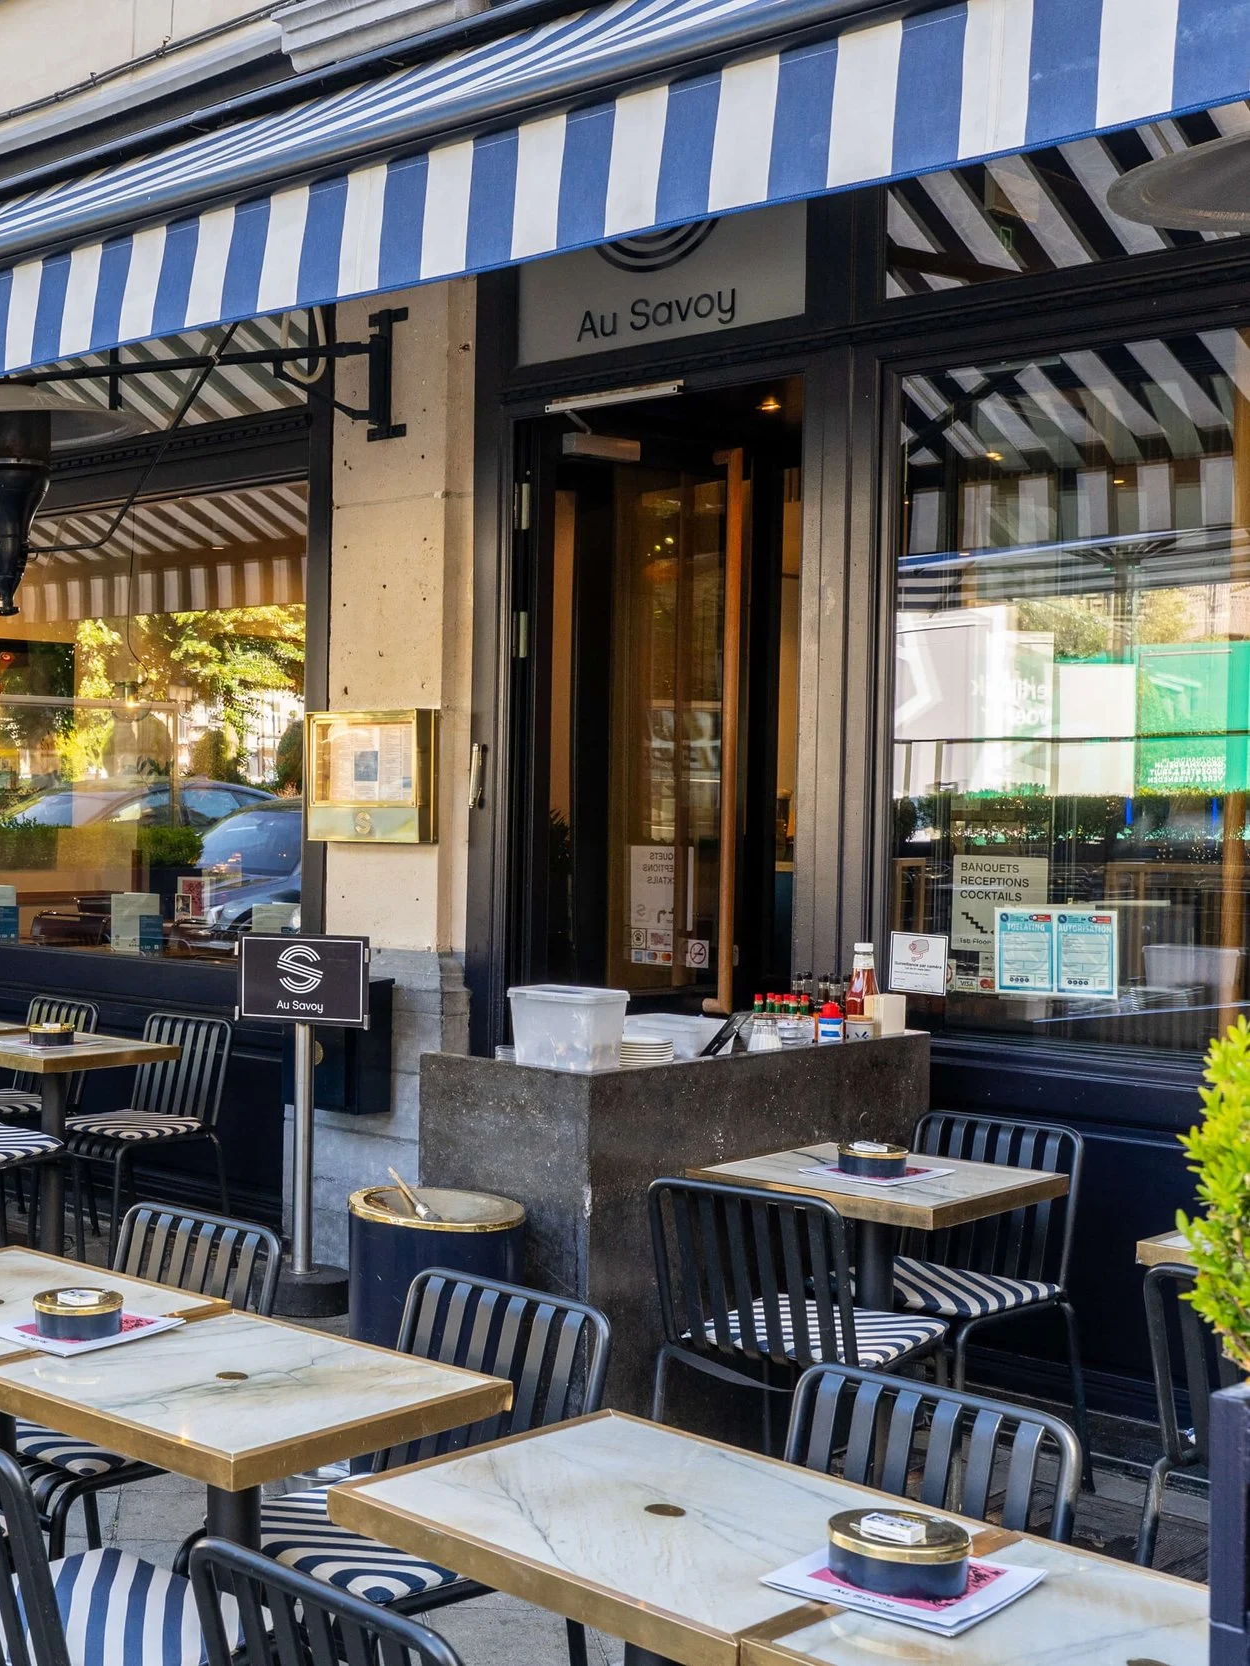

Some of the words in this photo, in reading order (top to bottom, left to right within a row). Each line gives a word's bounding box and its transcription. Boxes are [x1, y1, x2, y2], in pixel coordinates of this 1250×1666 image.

[576, 310, 617, 343] Au
[629, 287, 736, 331] Savoy
[961, 862, 1020, 874] BANQUETS
[960, 875, 1030, 888] RECEPTIONS
[959, 889, 1023, 902] COCKTAILS
[1007, 923, 1045, 931] TOELATING
[1058, 923, 1112, 933] AUTORISATION
[276, 999, 290, 1010] Au
[292, 1000, 324, 1014] Savoy
